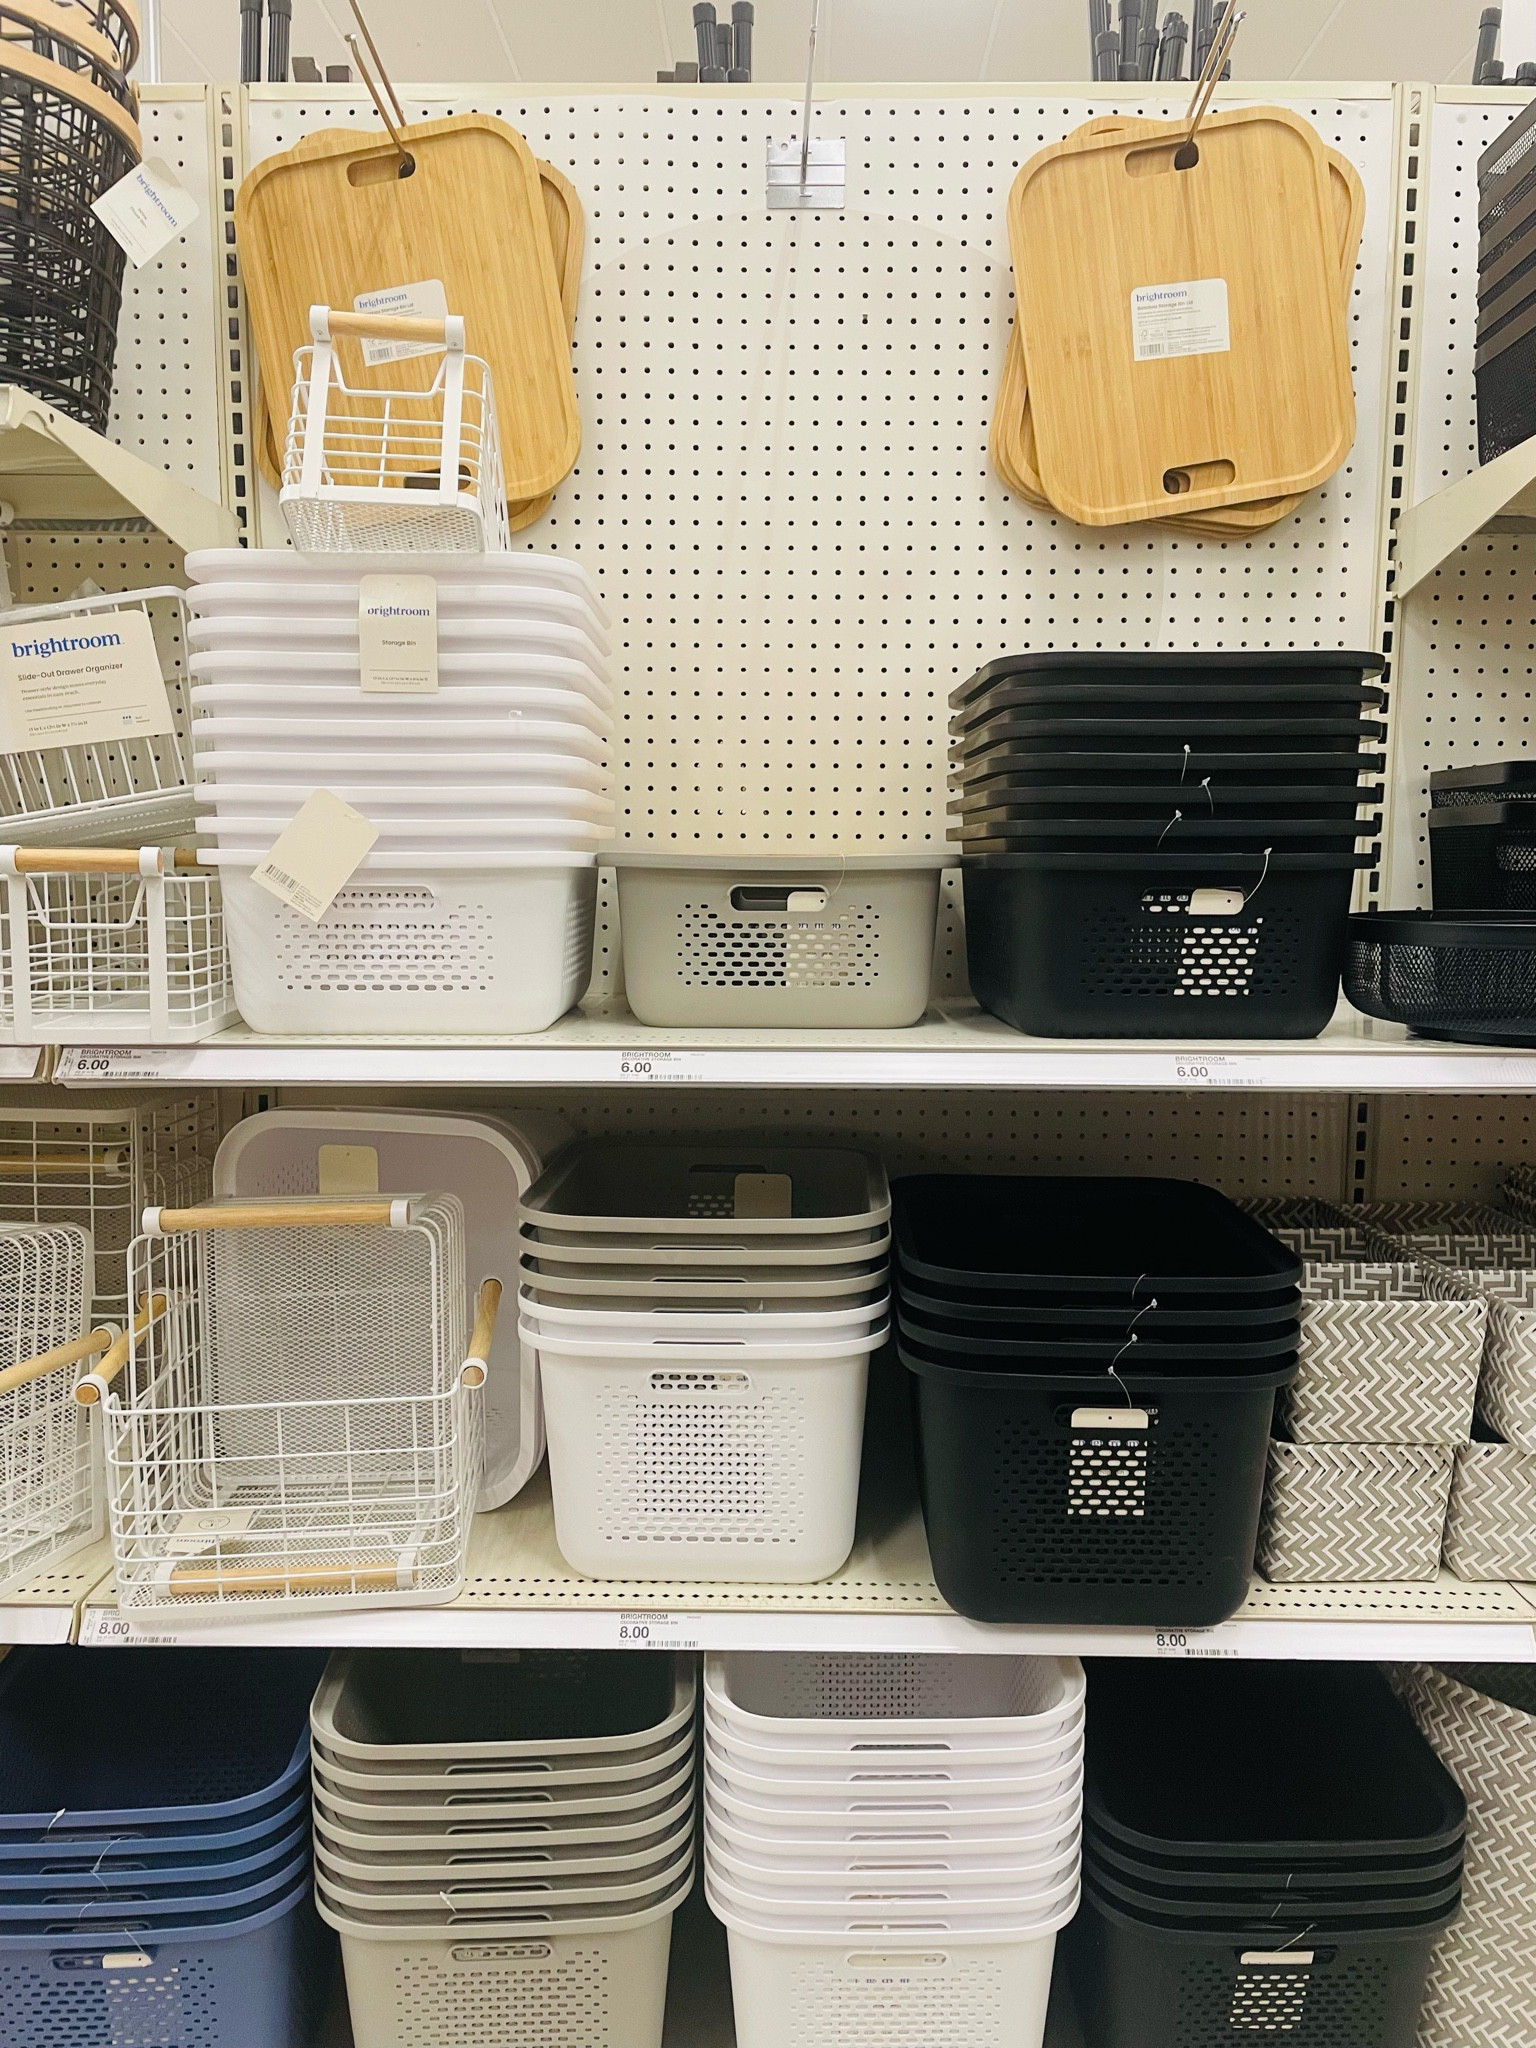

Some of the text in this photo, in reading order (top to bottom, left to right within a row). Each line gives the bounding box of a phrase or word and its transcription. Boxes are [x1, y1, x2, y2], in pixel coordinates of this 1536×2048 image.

[136, 174, 178, 228] brightroom
[359, 293, 408, 309] brightroom
[1136, 290, 1188, 302] brightroom
[11, 633, 121, 659] brightroom
[382, 639, 406, 647] Storage
[18, 662, 124, 682] Slide-Out Drawer Organizer
[77, 1059, 110, 1070] 6.00
[621, 1062, 652, 1073] 6.00
[1176, 1066, 1208, 1077] 6.00
[98, 1622, 130, 1635] 8.00
[619, 1626, 650, 1639] 8.00
[1156, 1633, 1187, 1646] 8.00
